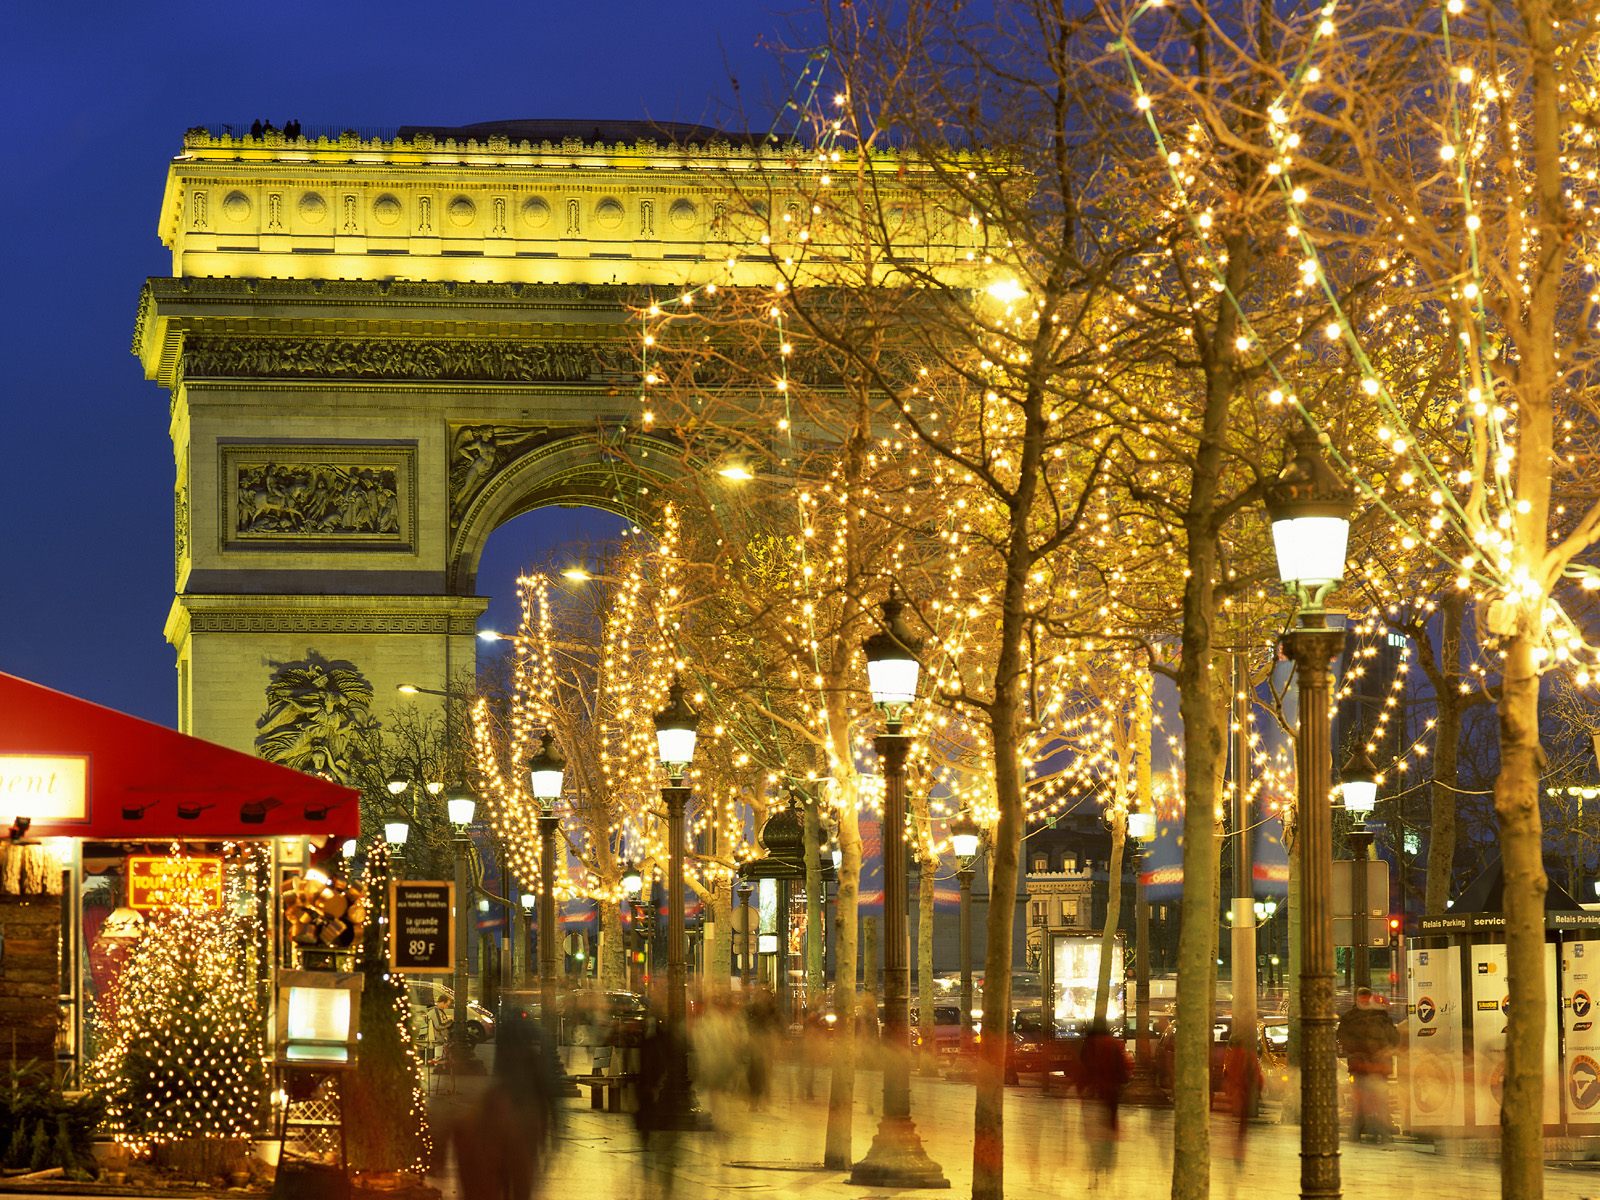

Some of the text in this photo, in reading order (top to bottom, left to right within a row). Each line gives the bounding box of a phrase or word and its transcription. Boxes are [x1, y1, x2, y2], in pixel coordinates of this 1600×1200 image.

[0, 771, 57, 794] ent
[405, 917, 438, 927] la grande
[1422, 919, 1466, 928] Relais Parking
[1556, 915, 1576, 923] Relais
[408, 940, 435, 955] 89 F
